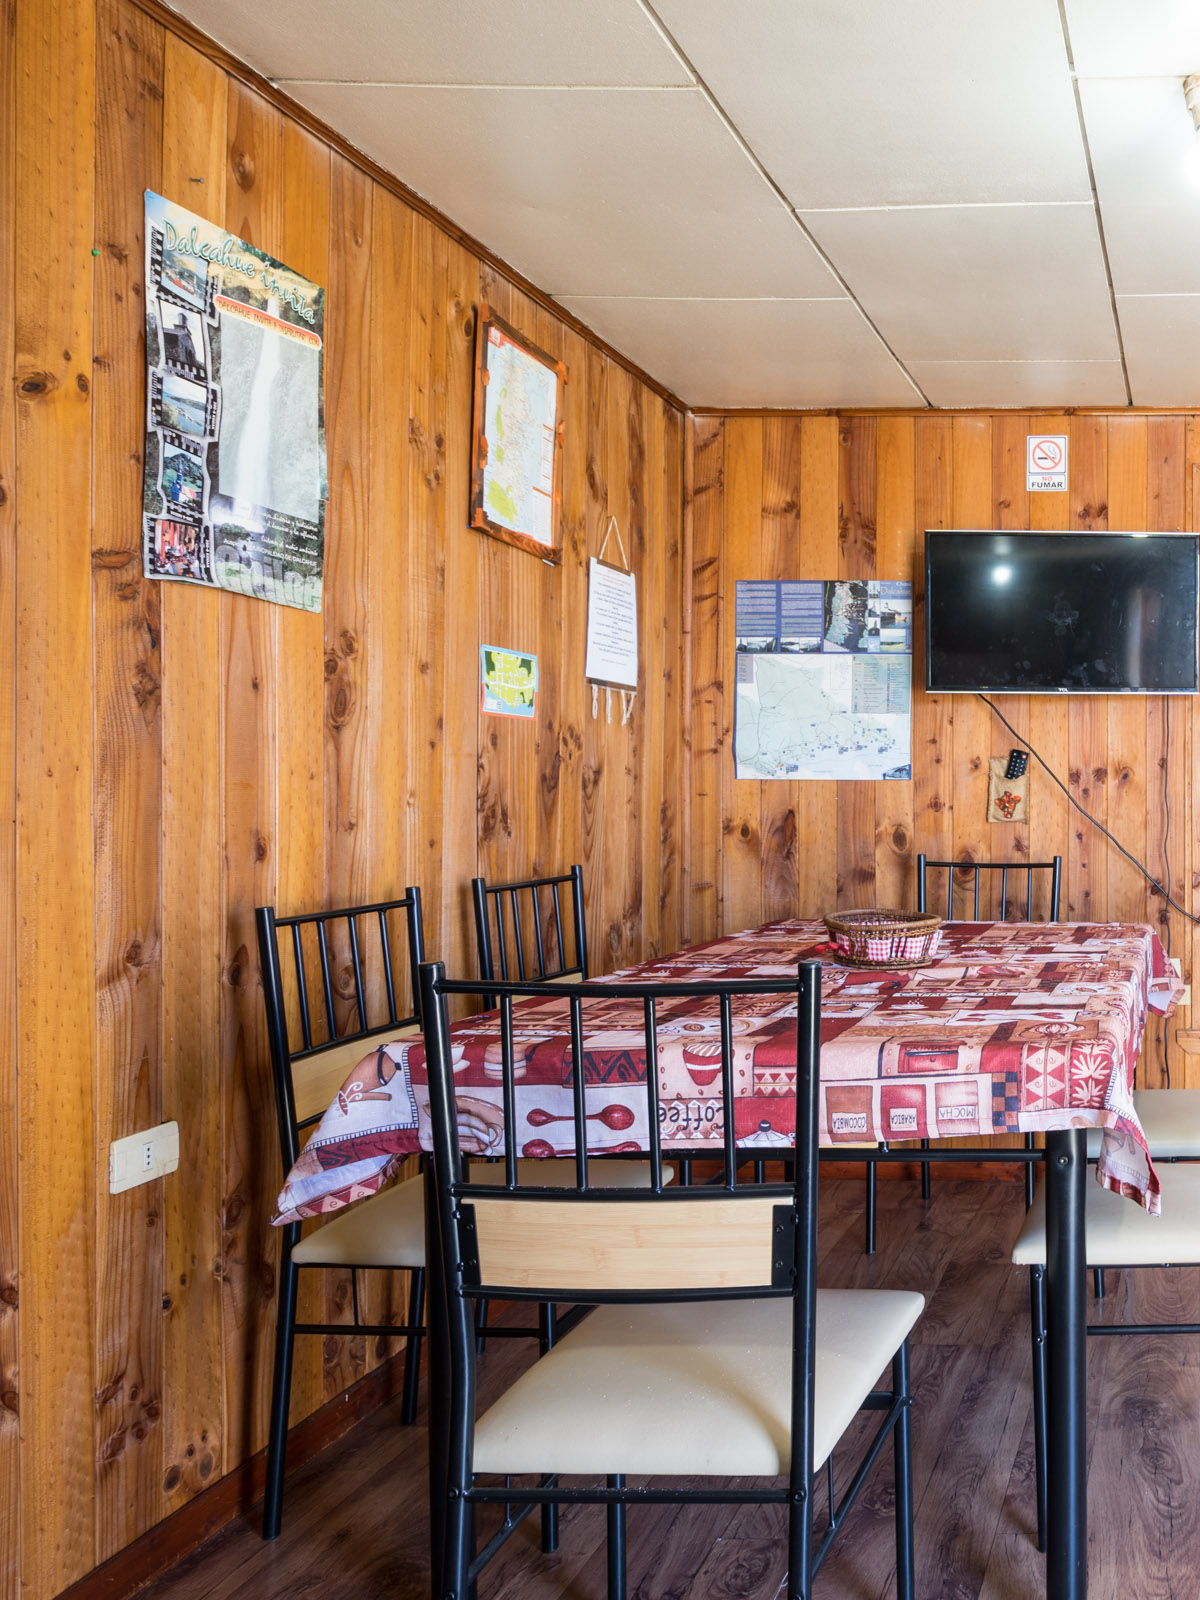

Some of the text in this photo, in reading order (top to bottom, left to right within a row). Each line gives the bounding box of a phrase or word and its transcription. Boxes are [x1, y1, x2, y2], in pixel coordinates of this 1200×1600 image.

[162, 218, 316, 325] Dalcahue invita
[939, 1107, 975, 1118] MOCHA
[890, 1113, 916, 1124] ARABICA
